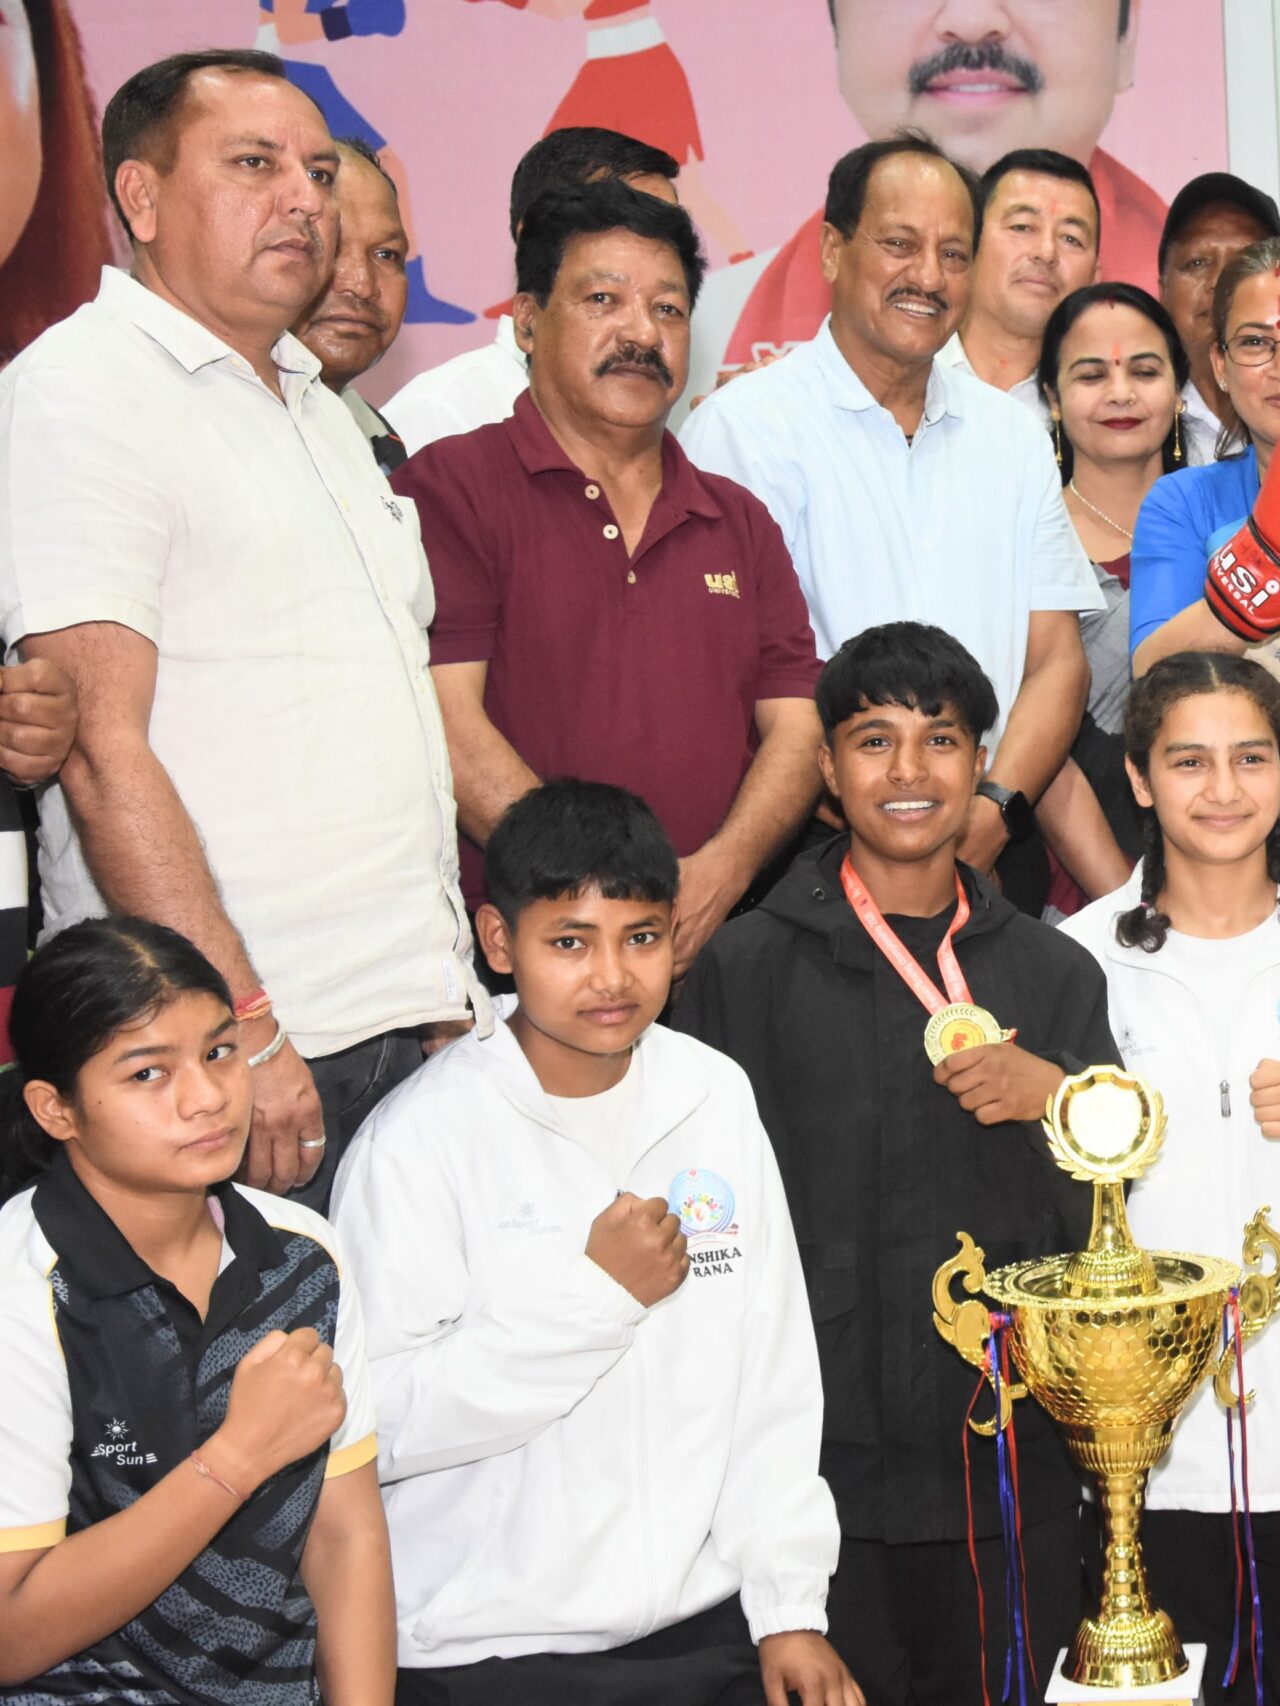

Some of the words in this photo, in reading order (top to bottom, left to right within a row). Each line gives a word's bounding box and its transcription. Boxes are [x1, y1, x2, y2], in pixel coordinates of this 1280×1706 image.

[689, 1246, 743, 1265] NSHIKA
[693, 1262, 734, 1278] RANA
[98, 1441, 137, 1458] Sport
[116, 1454, 144, 1466] Sun
